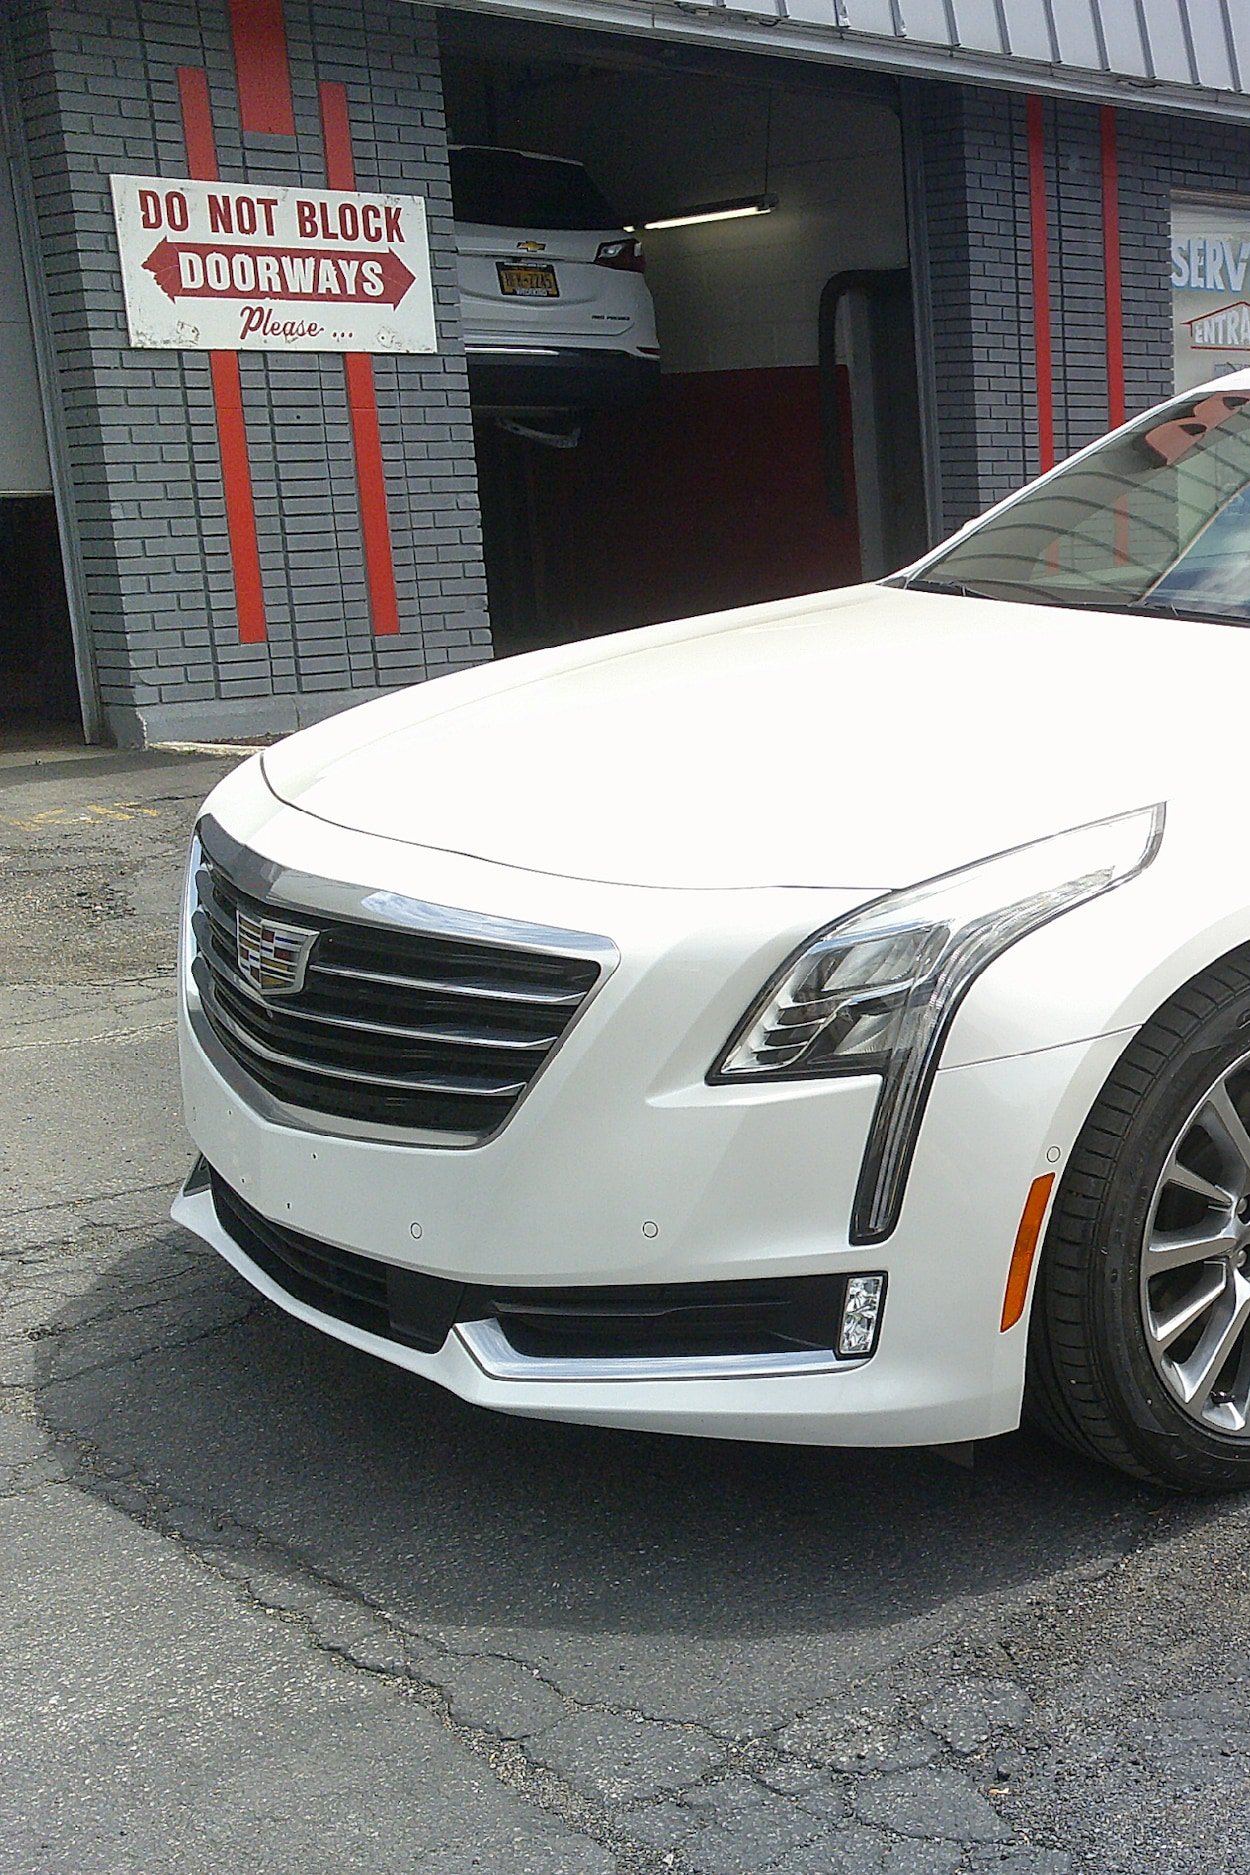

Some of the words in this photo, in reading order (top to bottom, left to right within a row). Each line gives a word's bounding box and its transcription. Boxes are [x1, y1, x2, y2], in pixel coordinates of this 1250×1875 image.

[139, 189, 190, 232] DO
[207, 194, 278, 236] NOT
[296, 200, 405, 243] BLOCK
[178, 251, 385, 297] DOORWAYS
[240, 305, 325, 340] Please
